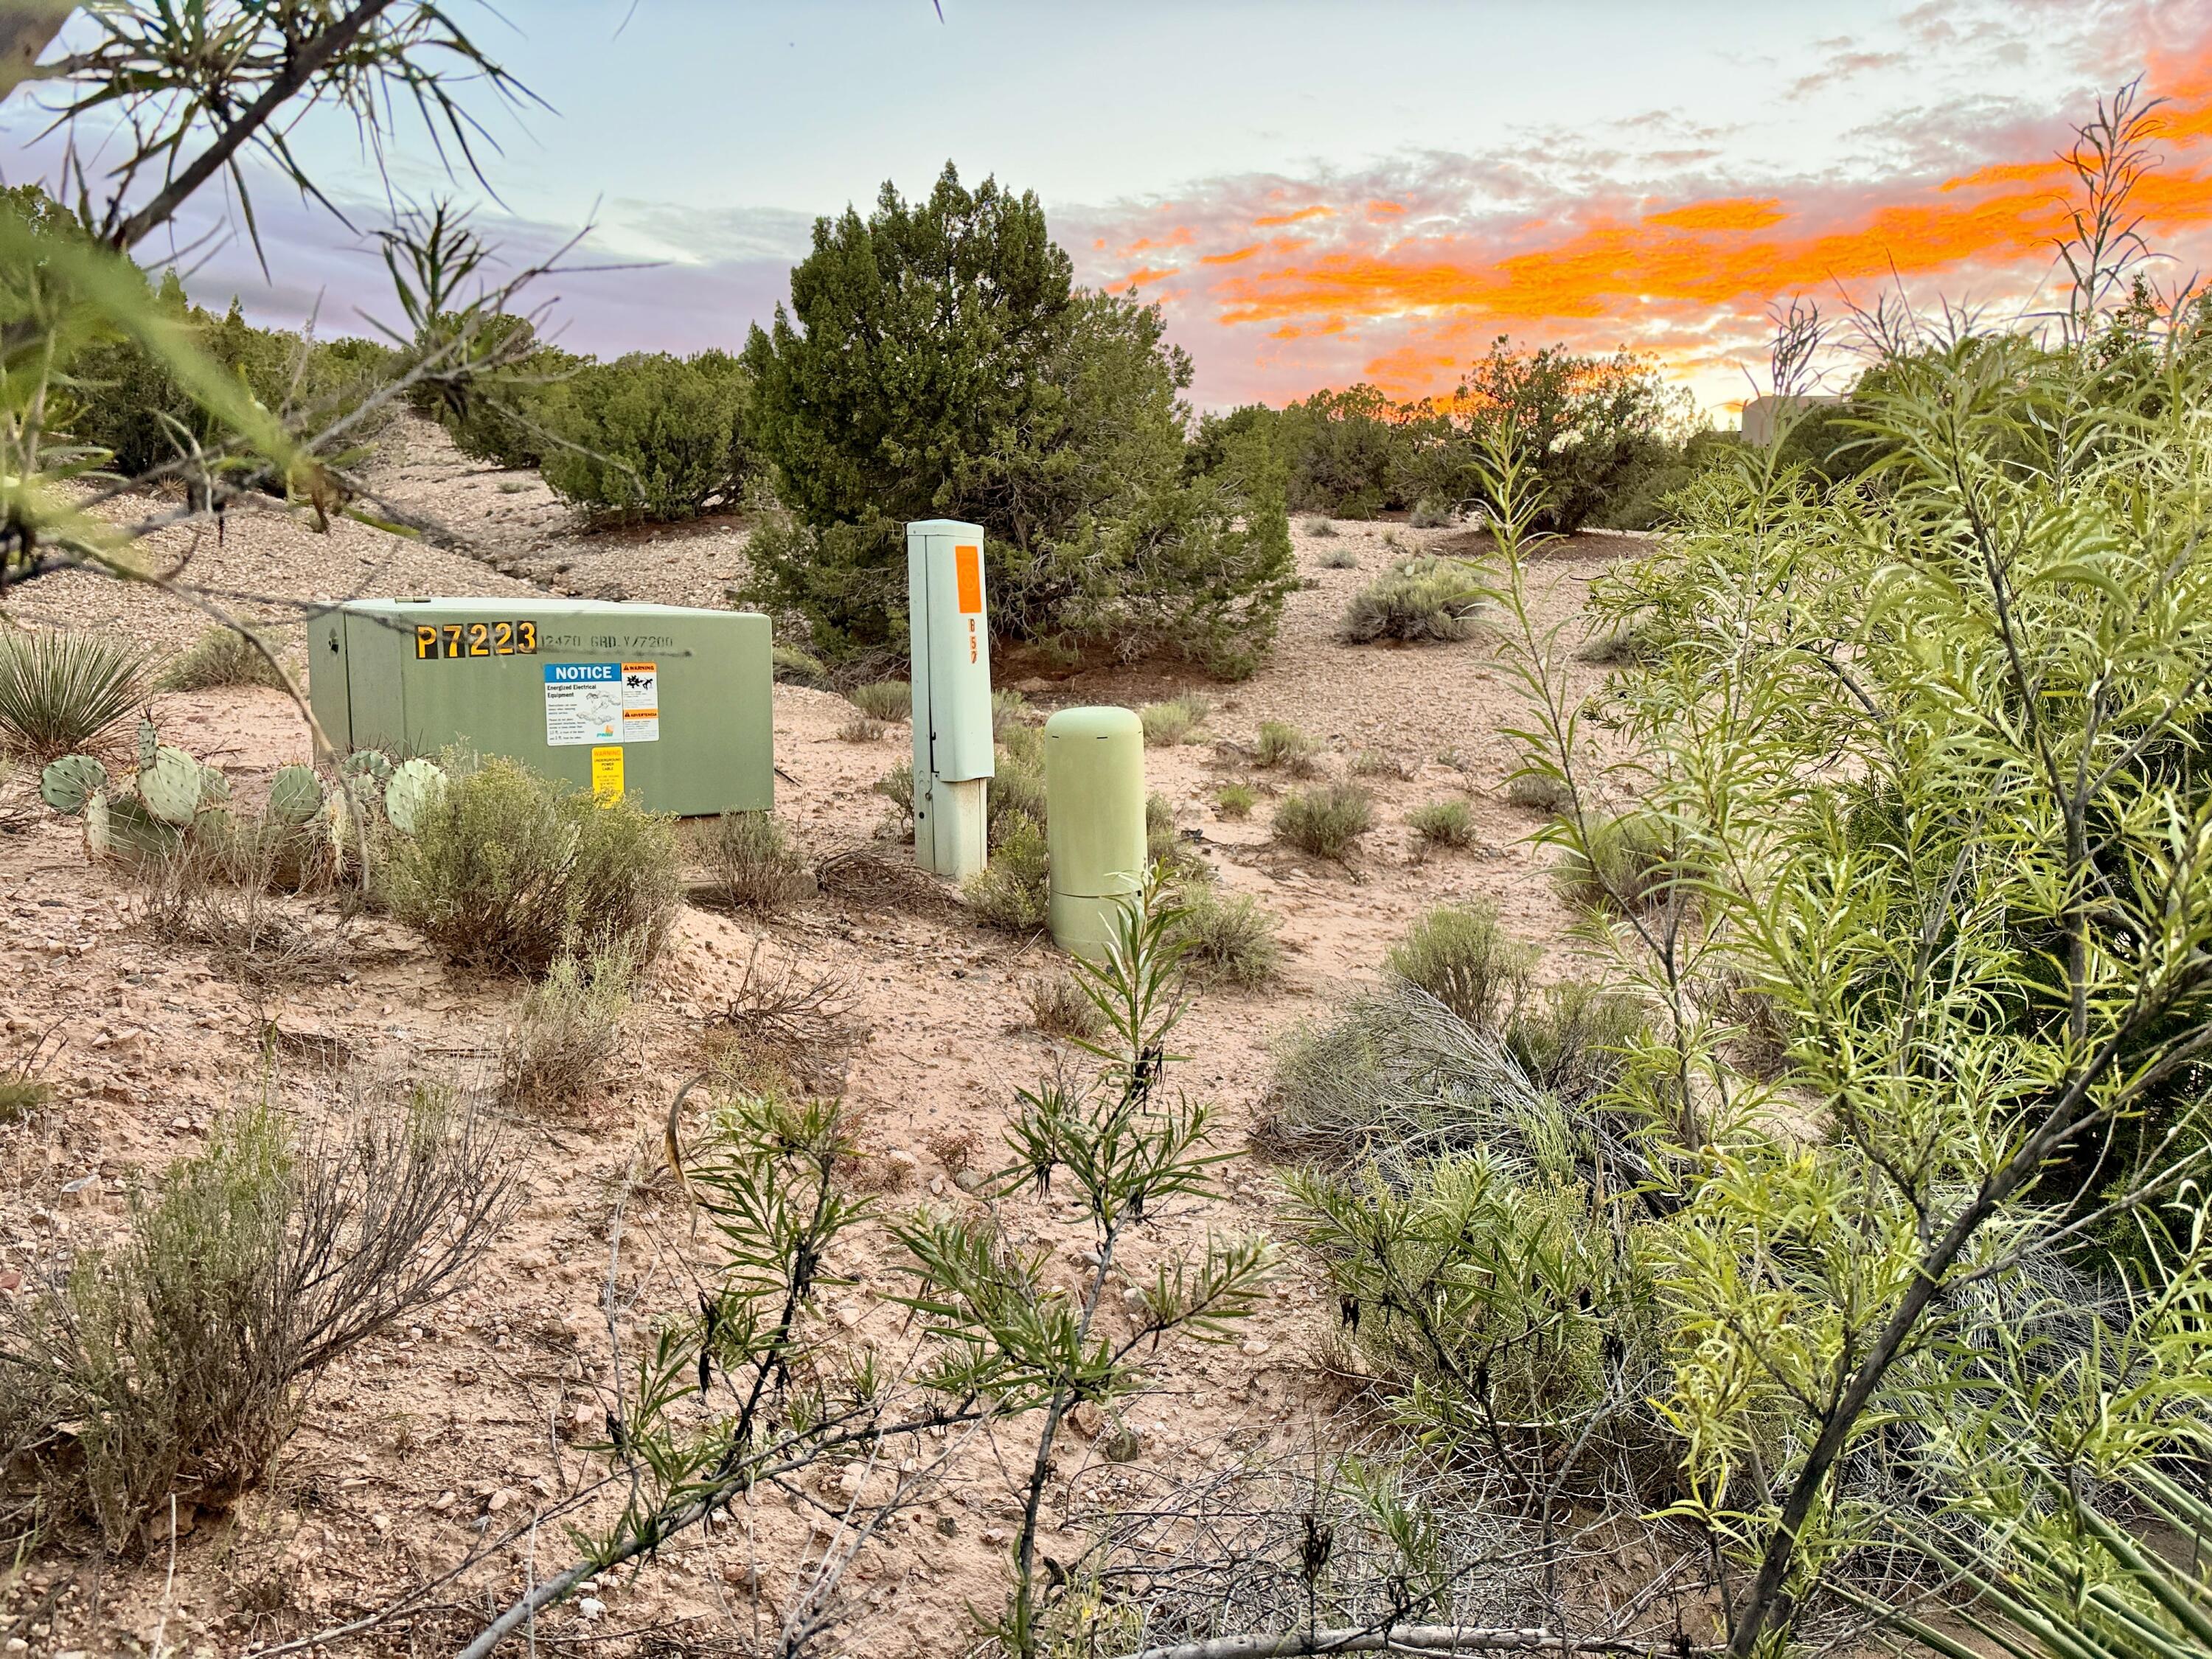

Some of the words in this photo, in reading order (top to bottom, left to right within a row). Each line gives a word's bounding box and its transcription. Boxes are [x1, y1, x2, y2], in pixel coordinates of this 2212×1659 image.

[417, 622, 535, 658] P7223
[540, 635, 581, 647] 12470
[555, 666, 613, 680] NOTICE
